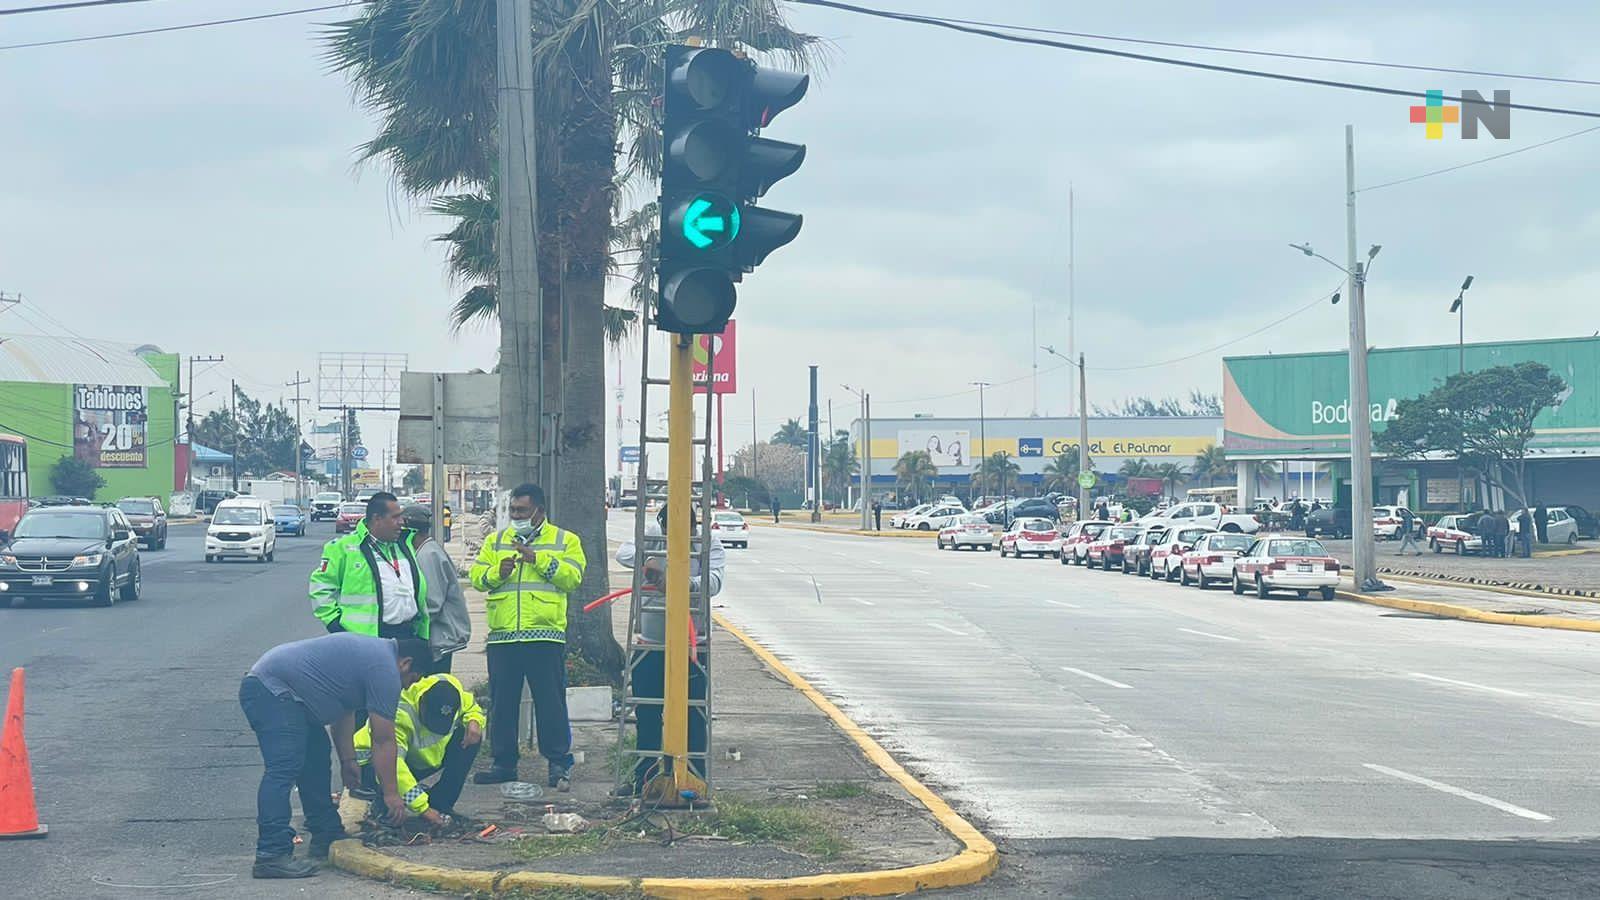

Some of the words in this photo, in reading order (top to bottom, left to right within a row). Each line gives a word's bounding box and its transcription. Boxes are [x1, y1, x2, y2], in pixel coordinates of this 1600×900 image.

[79, 388, 141, 410] Tablones
[1312, 400, 1382, 424] Boda
[1051, 441, 1105, 454] Coel
[1127, 443, 1171, 453] Palmar
[100, 452, 143, 462] descuento
